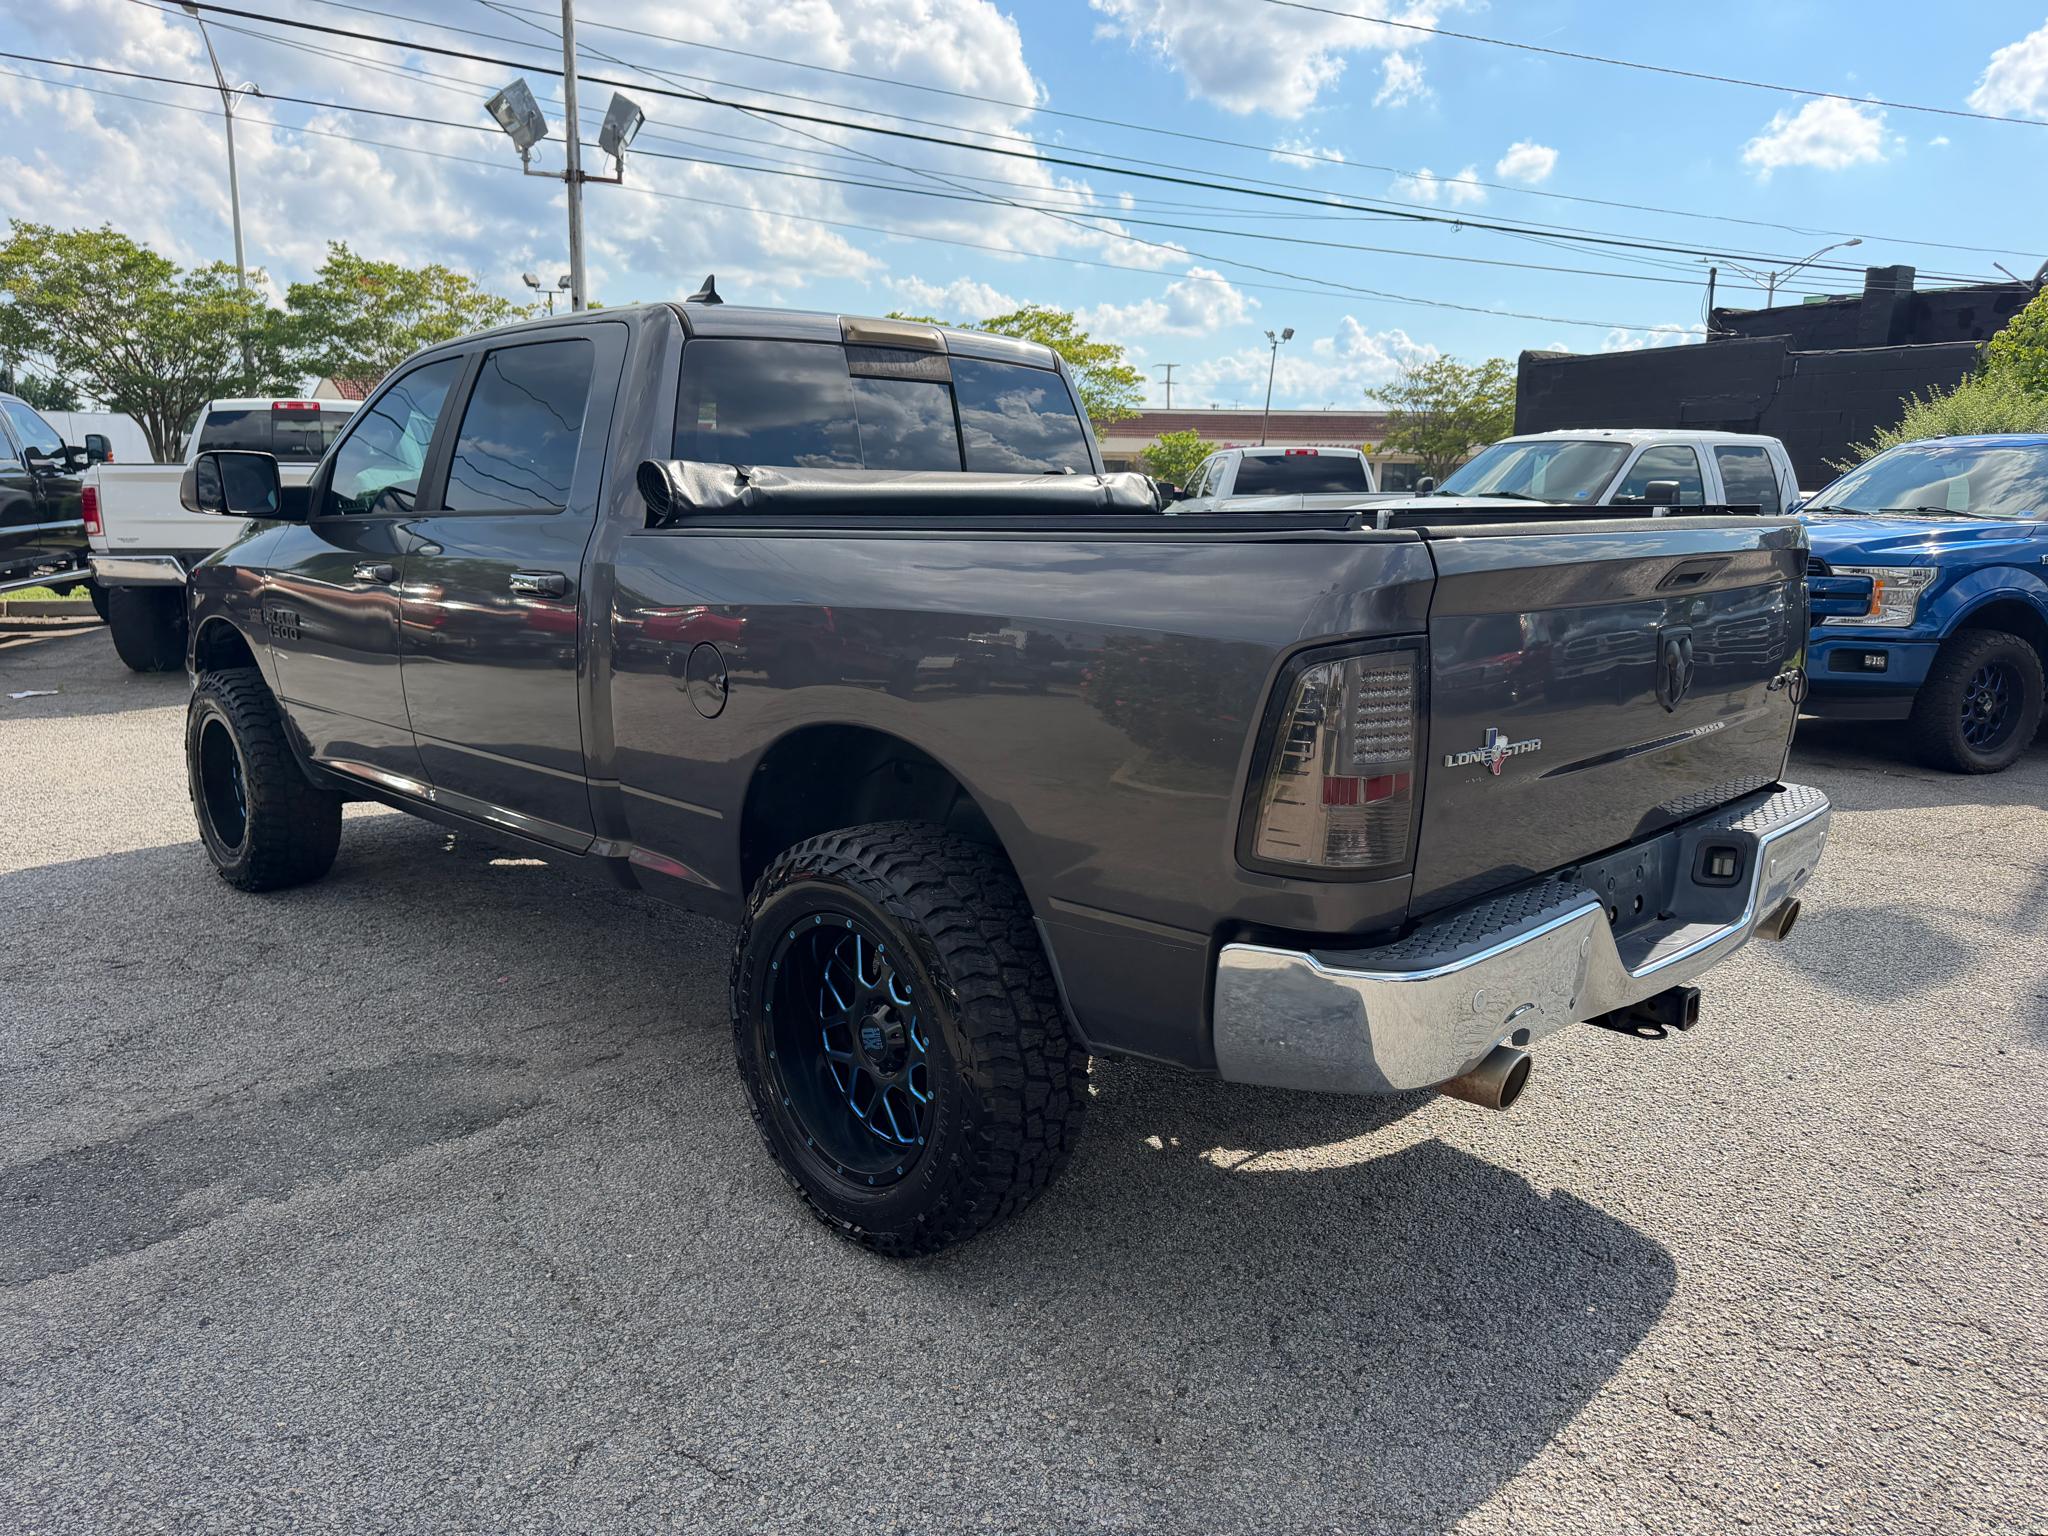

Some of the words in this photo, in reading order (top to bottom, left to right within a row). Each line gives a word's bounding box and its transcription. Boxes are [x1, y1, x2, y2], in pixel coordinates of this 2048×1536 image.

[265, 608, 296, 626] RAM
[1444, 749, 1492, 767] LONE
[1502, 738, 1542, 757] STAR
